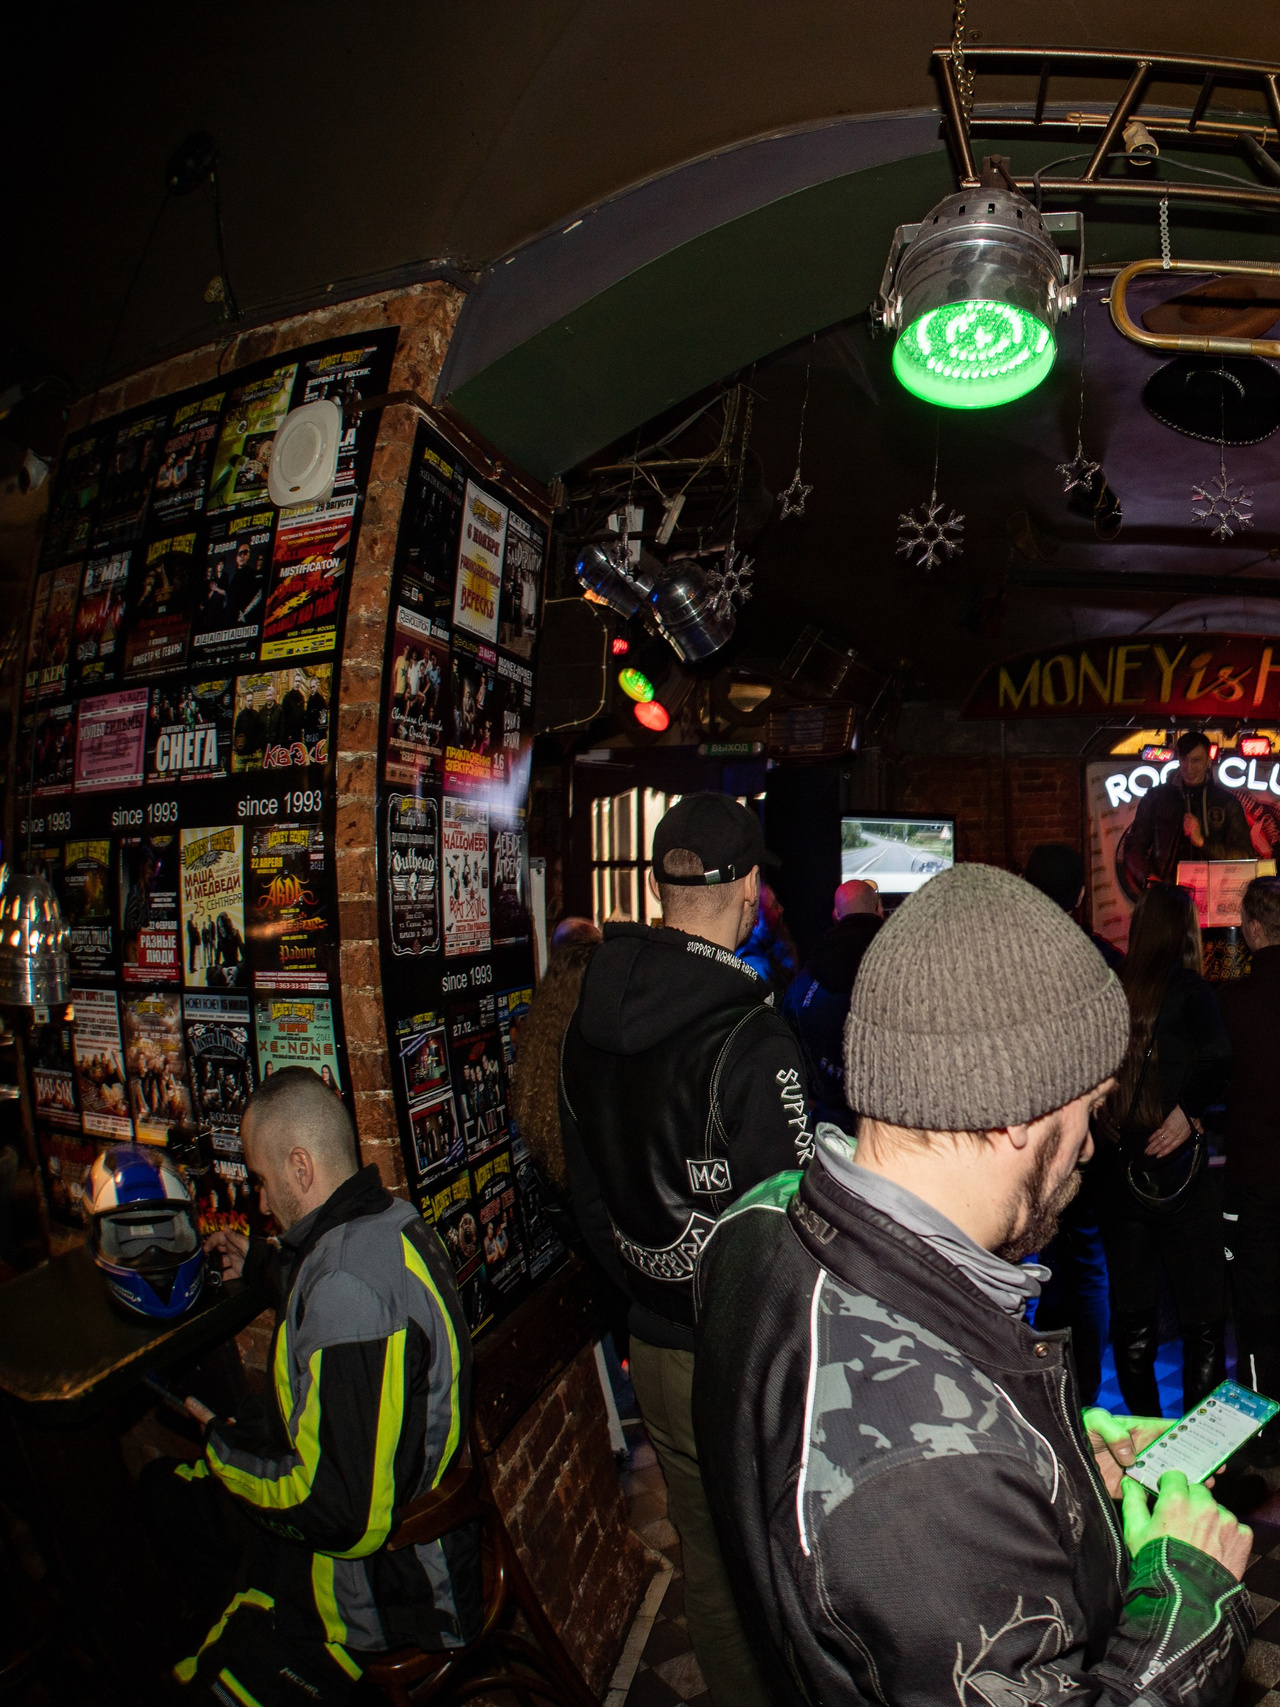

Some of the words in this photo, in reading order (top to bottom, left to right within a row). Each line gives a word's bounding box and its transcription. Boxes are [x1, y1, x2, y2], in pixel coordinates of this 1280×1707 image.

[998, 642, 1188, 712] MONEY
[1184, 649, 1253, 702] is
[711, 743, 749, 753] ВЫХОД
[1104, 759, 1181, 808] ROC
[112, 804, 143, 828] since
[146, 800, 179, 824] 1993
[237, 794, 279, 817] since
[284, 789, 323, 814] 1993
[20, 815, 45, 834] since
[48, 811, 72, 832] 1993
[443, 832, 488, 852] HALLOWEEN
[184, 868, 215, 888] МАША
[185, 890, 193, 902] И
[194, 874, 241, 899] МЕДВЕДИ
[193, 900, 205, 917] 25
[206, 892, 243, 911] СЕНТЯБРЯ
[140, 933, 177, 949] РАЗНЫЕ
[145, 949, 175, 964] ЛЮДИ
[687, 941, 717, 959] SUPPORT
[715, 948, 742, 970] NORMANS
[441, 971, 468, 993] since
[469, 963, 493, 986] 1993
[259, 1039, 334, 1056] XE-NONE
[775, 1067, 816, 1165] SUPPOR
[213, 1159, 220, 1174] 3
[220, 1160, 249, 1179] МАРТА
[691, 1162, 728, 1190] MC
